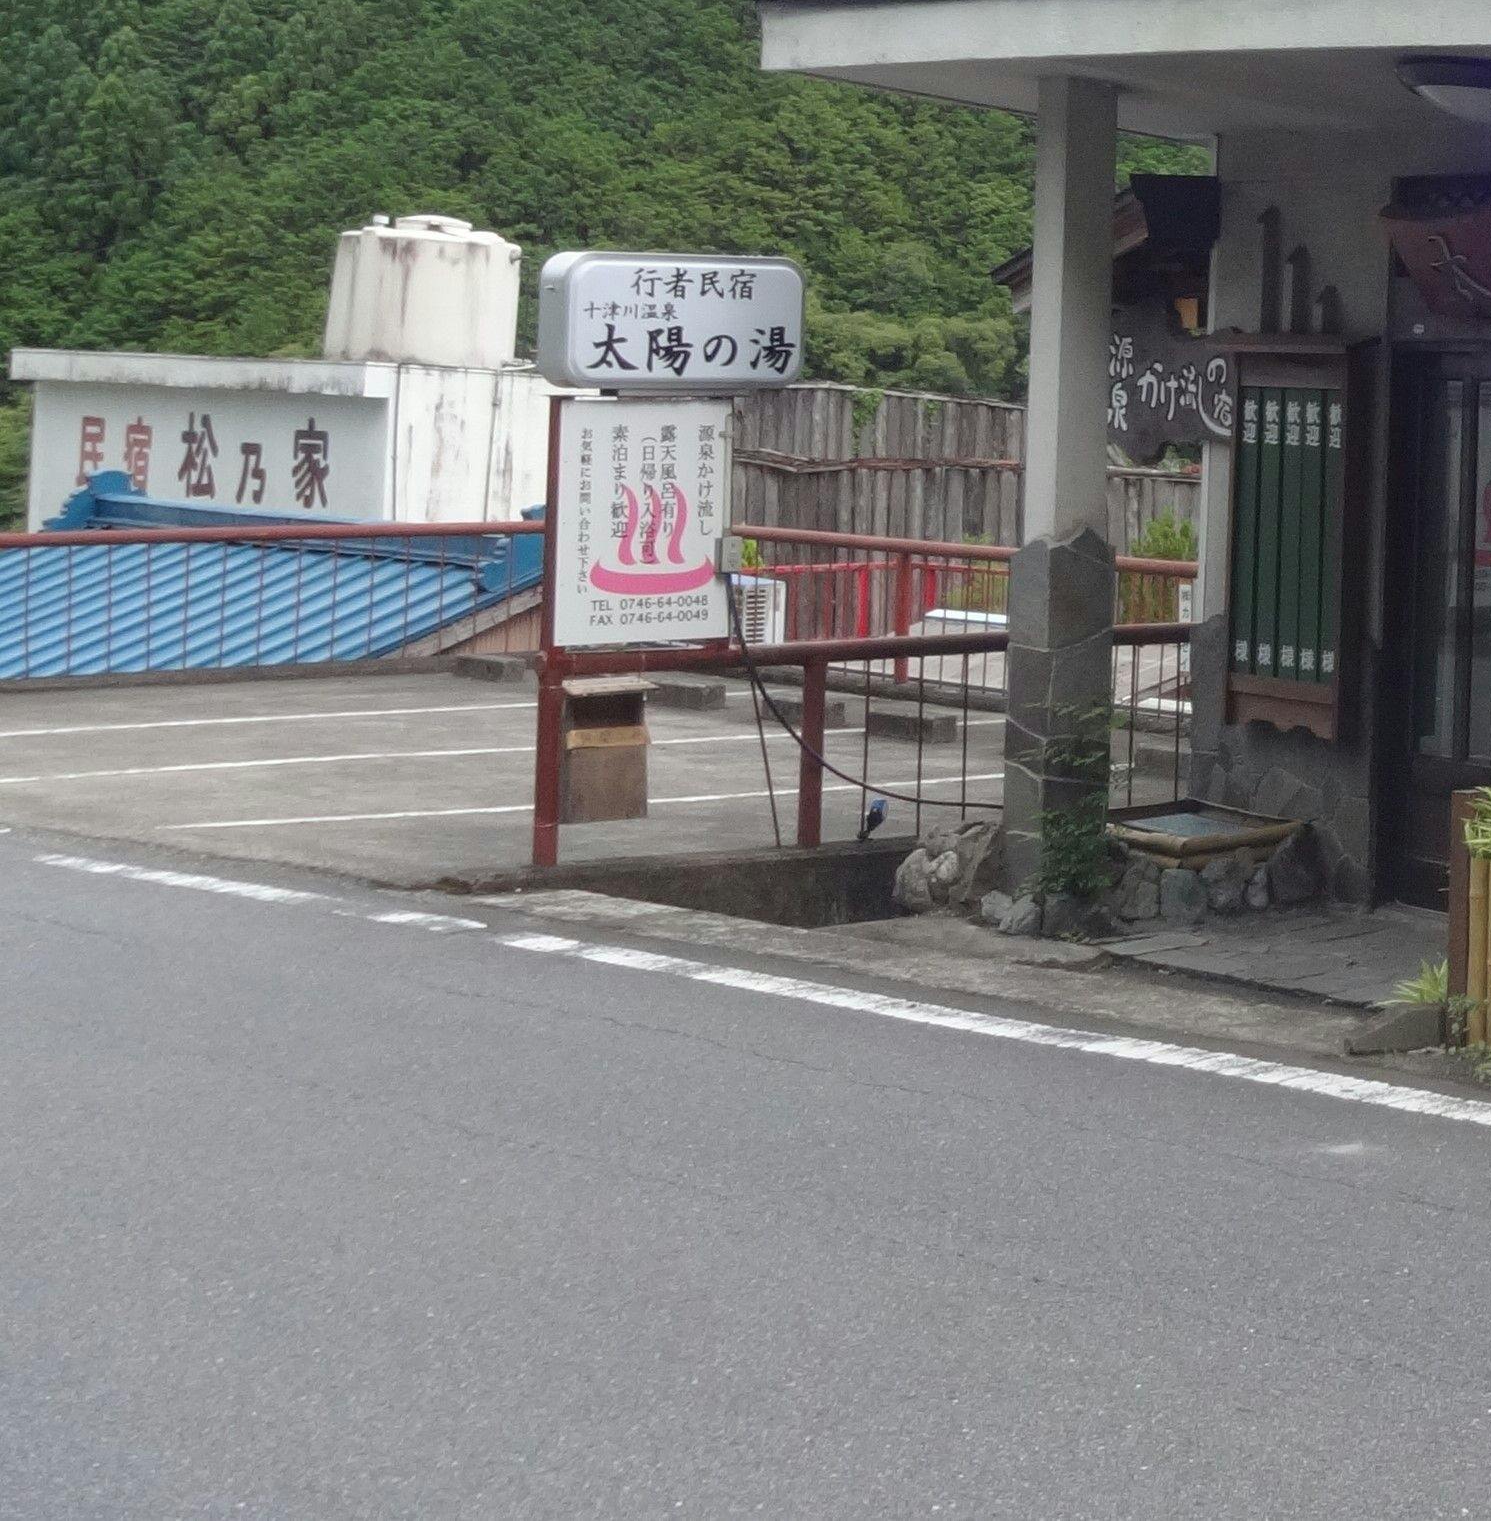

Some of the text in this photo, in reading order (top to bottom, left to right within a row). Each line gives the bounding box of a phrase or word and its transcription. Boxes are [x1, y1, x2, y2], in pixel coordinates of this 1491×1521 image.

[583, 301, 680, 322] 十津川温泉
[630, 266, 758, 301] 行者民宿
[586, 323, 797, 377] 太陽の湯
[178, 411, 330, 509] 松乃家
[611, 424, 630, 539] 素泊まり歓迎
[660, 424, 678, 538] 露天風呂有り
[697, 424, 716, 536] 源泉かけ流し
[576, 428, 594, 594] お気軽にお問い合わせ下さい
[589, 609, 709, 626] FAX 0746-64-0049
[591, 594, 709, 612] TEL 0746-64-0048
